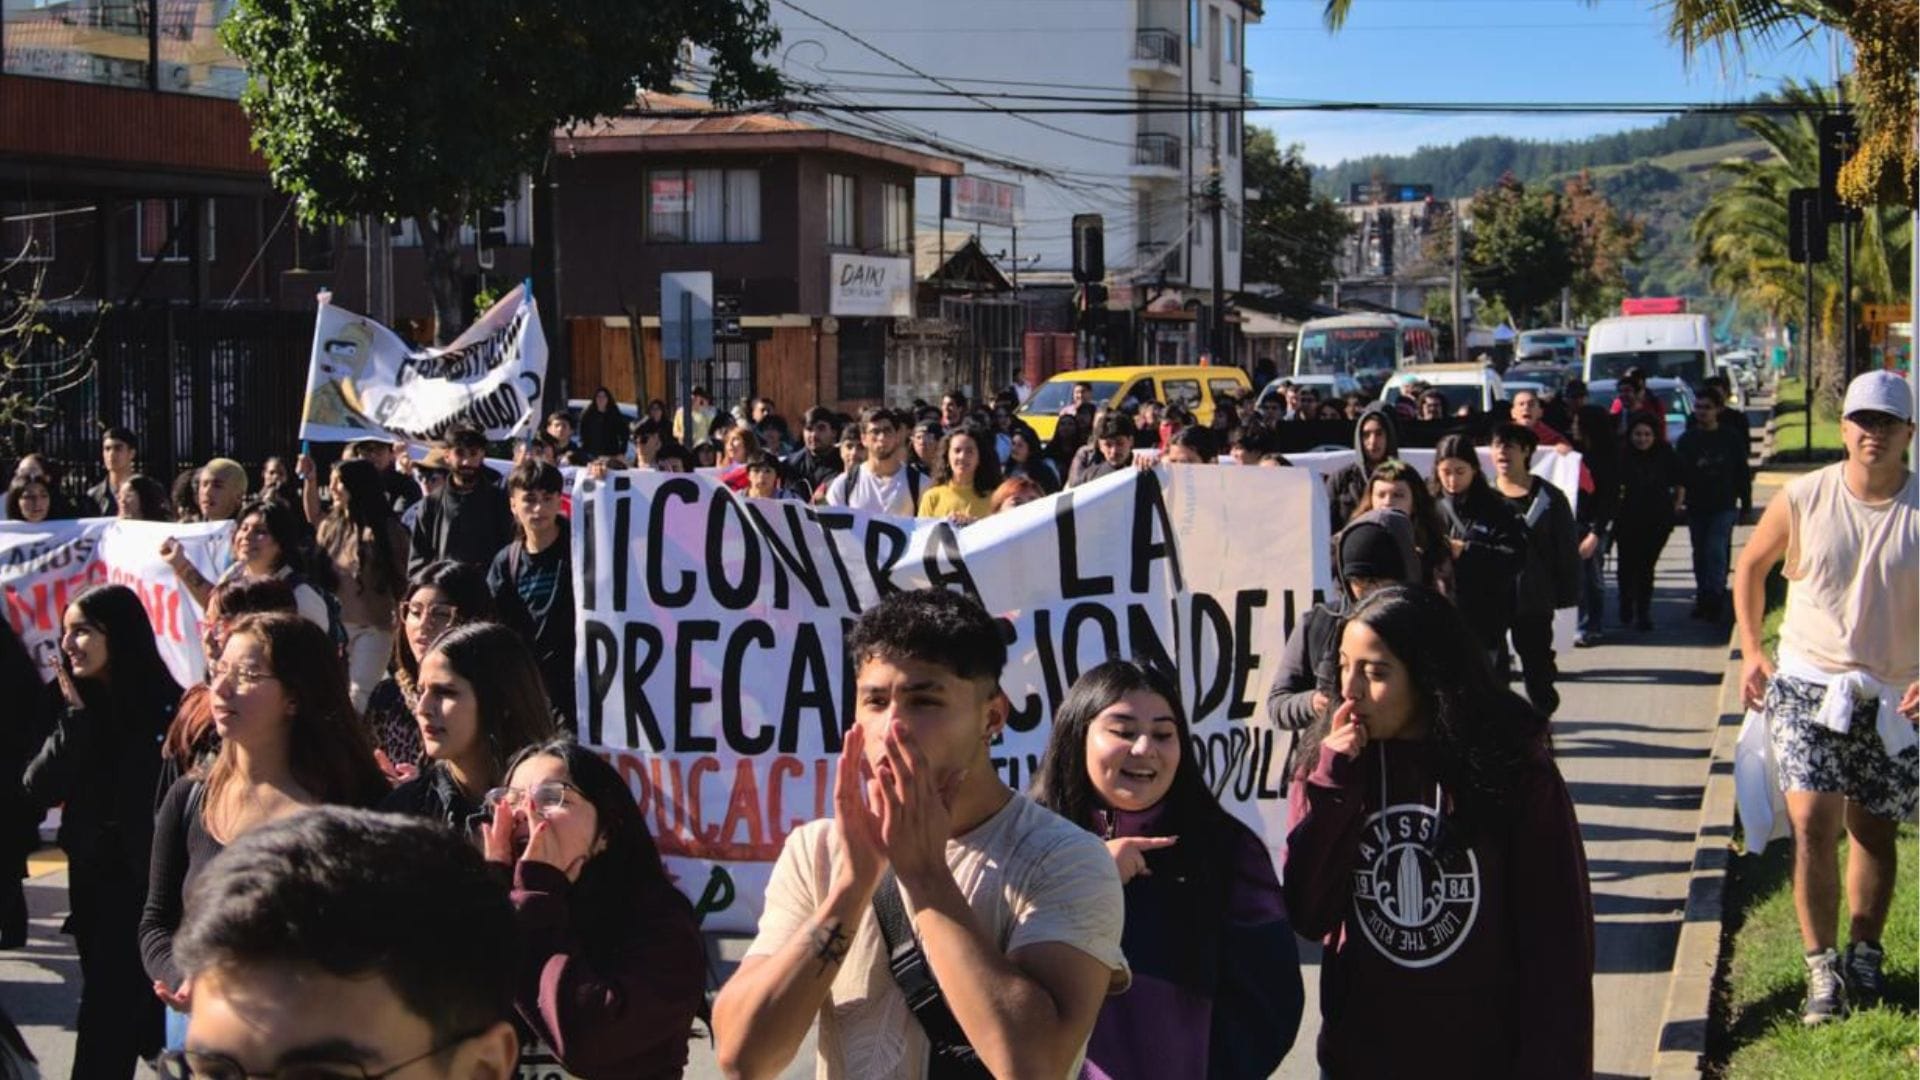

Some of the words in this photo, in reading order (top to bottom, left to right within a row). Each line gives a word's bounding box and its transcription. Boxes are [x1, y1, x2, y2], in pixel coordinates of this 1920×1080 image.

[1055, 470, 1183, 599] LA
[1191, 588, 1268, 724] DE
[1450, 878, 1470, 898] 84
[1367, 910, 1396, 945] RIDE
[1399, 931, 1428, 951] THE
[1428, 911, 1462, 946] LOVE
